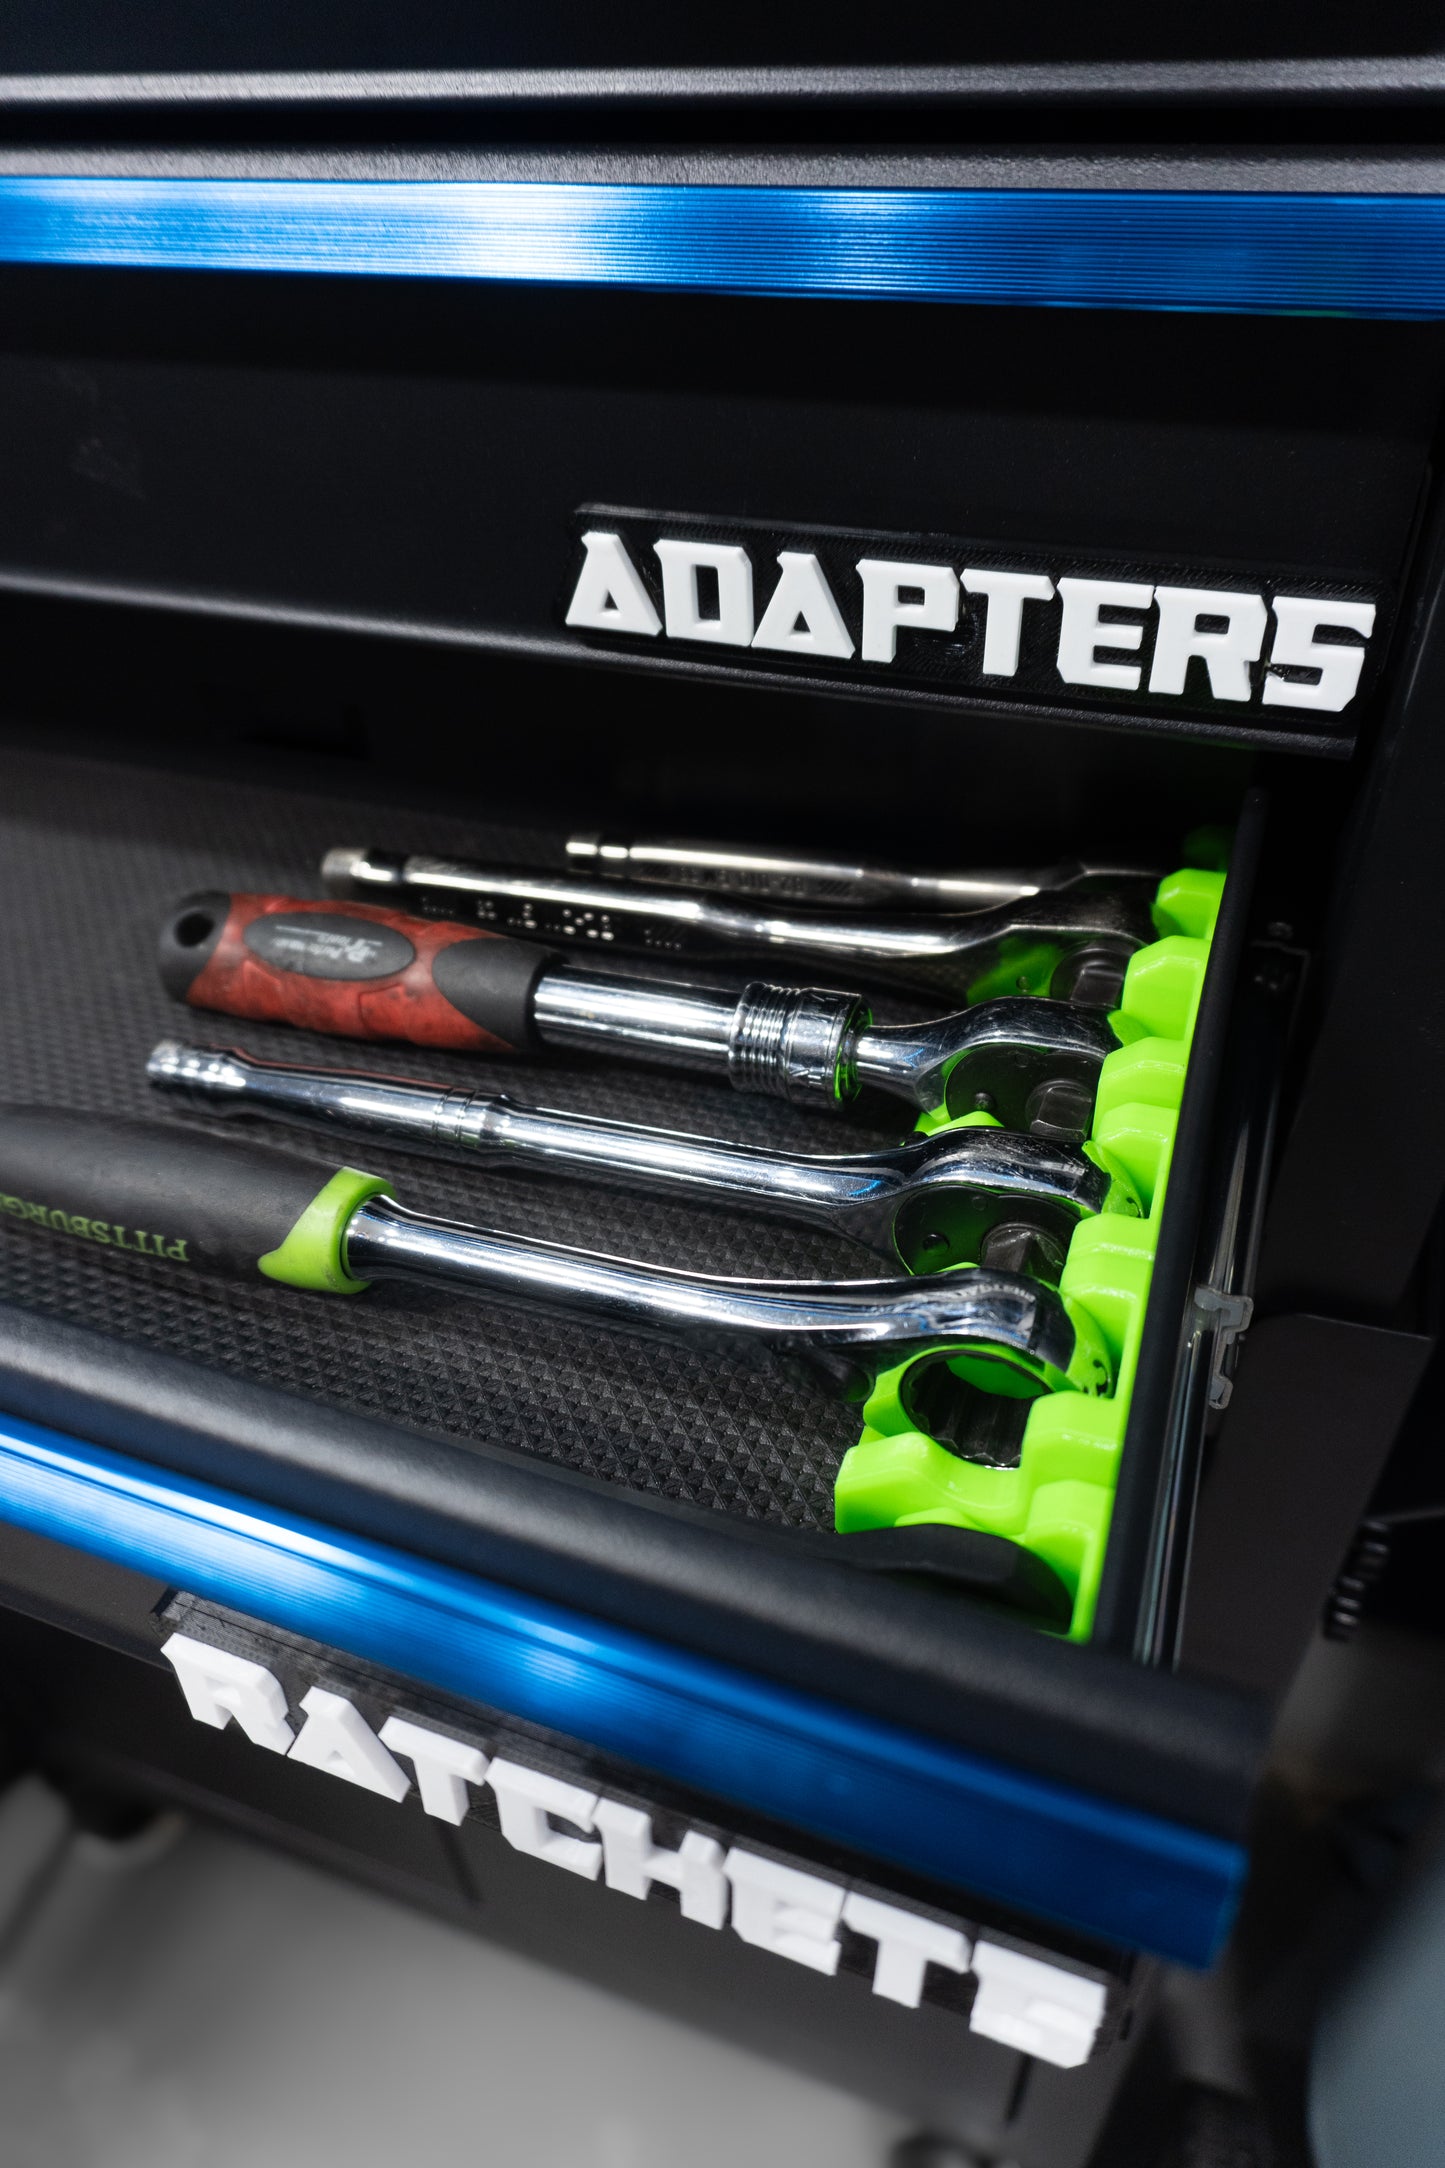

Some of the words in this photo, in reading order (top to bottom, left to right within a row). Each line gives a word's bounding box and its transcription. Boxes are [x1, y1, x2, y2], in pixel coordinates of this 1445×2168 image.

[564, 530, 1377, 713] ADAPTERS
[0, 1193, 191, 1263] PITTSBURG
[160, 1632, 1108, 2069] RATCHETS
